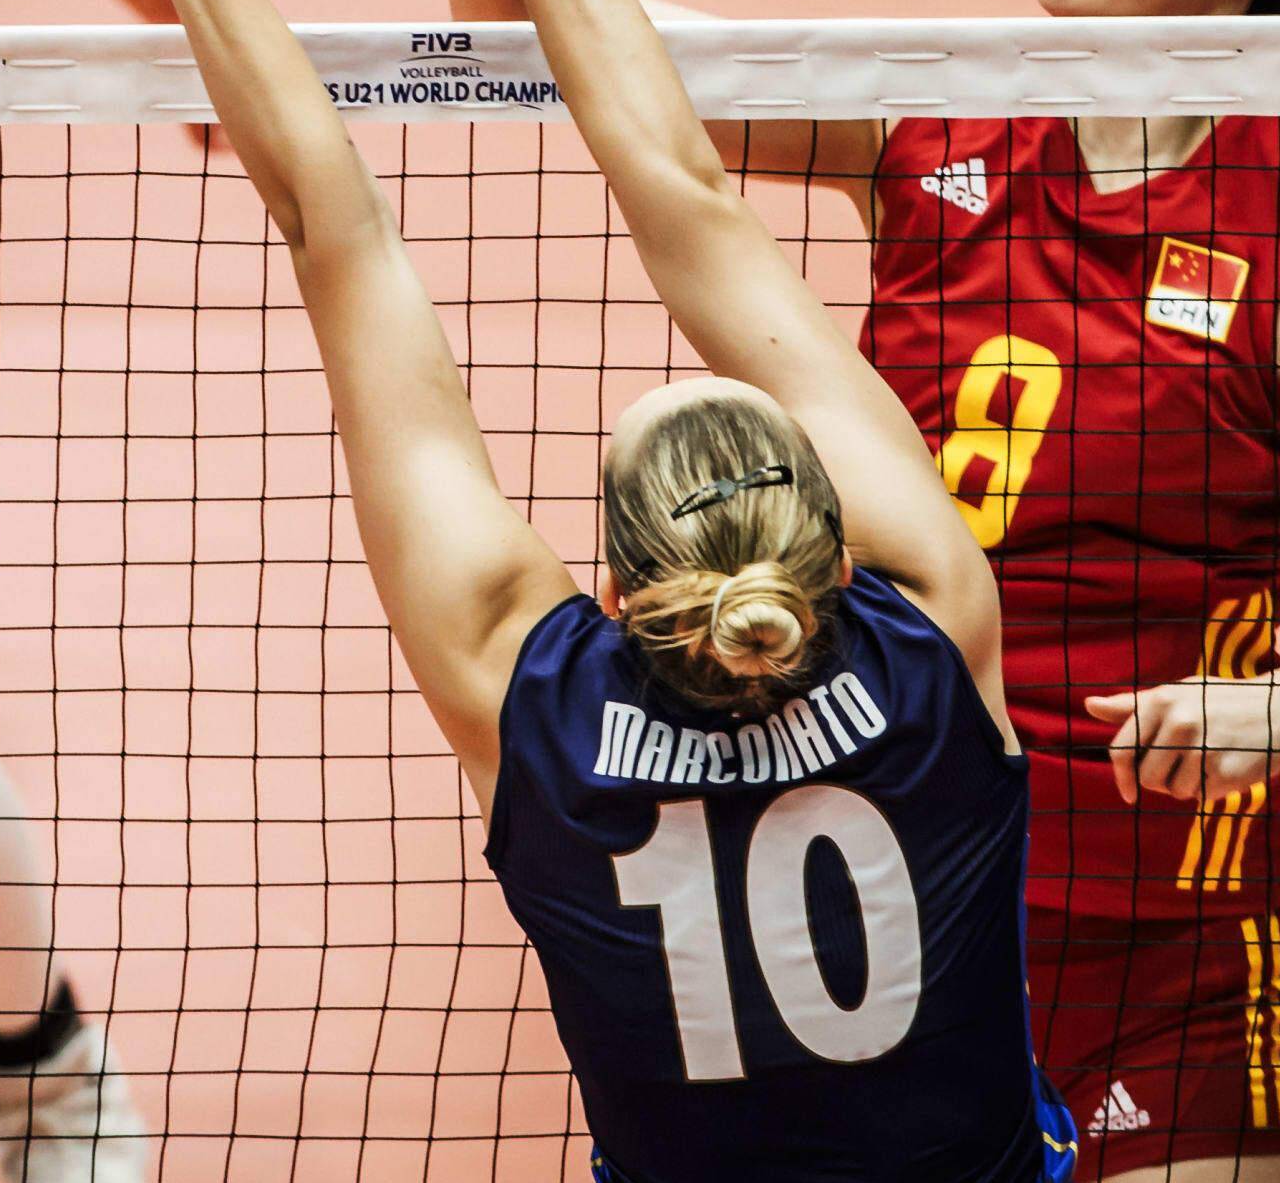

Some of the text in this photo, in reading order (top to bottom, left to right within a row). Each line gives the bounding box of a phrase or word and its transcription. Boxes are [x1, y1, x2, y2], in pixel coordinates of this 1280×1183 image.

[345, 82, 384, 104] U21
[390, 82, 470, 103] WORLD
[475, 81, 564, 103] CHAMPI
[400, 67, 484, 79] VOLLEYBALL
[935, 334, 1063, 549] 8
[593, 671, 887, 784] MARCONATO
[610, 783, 923, 1082] 10
